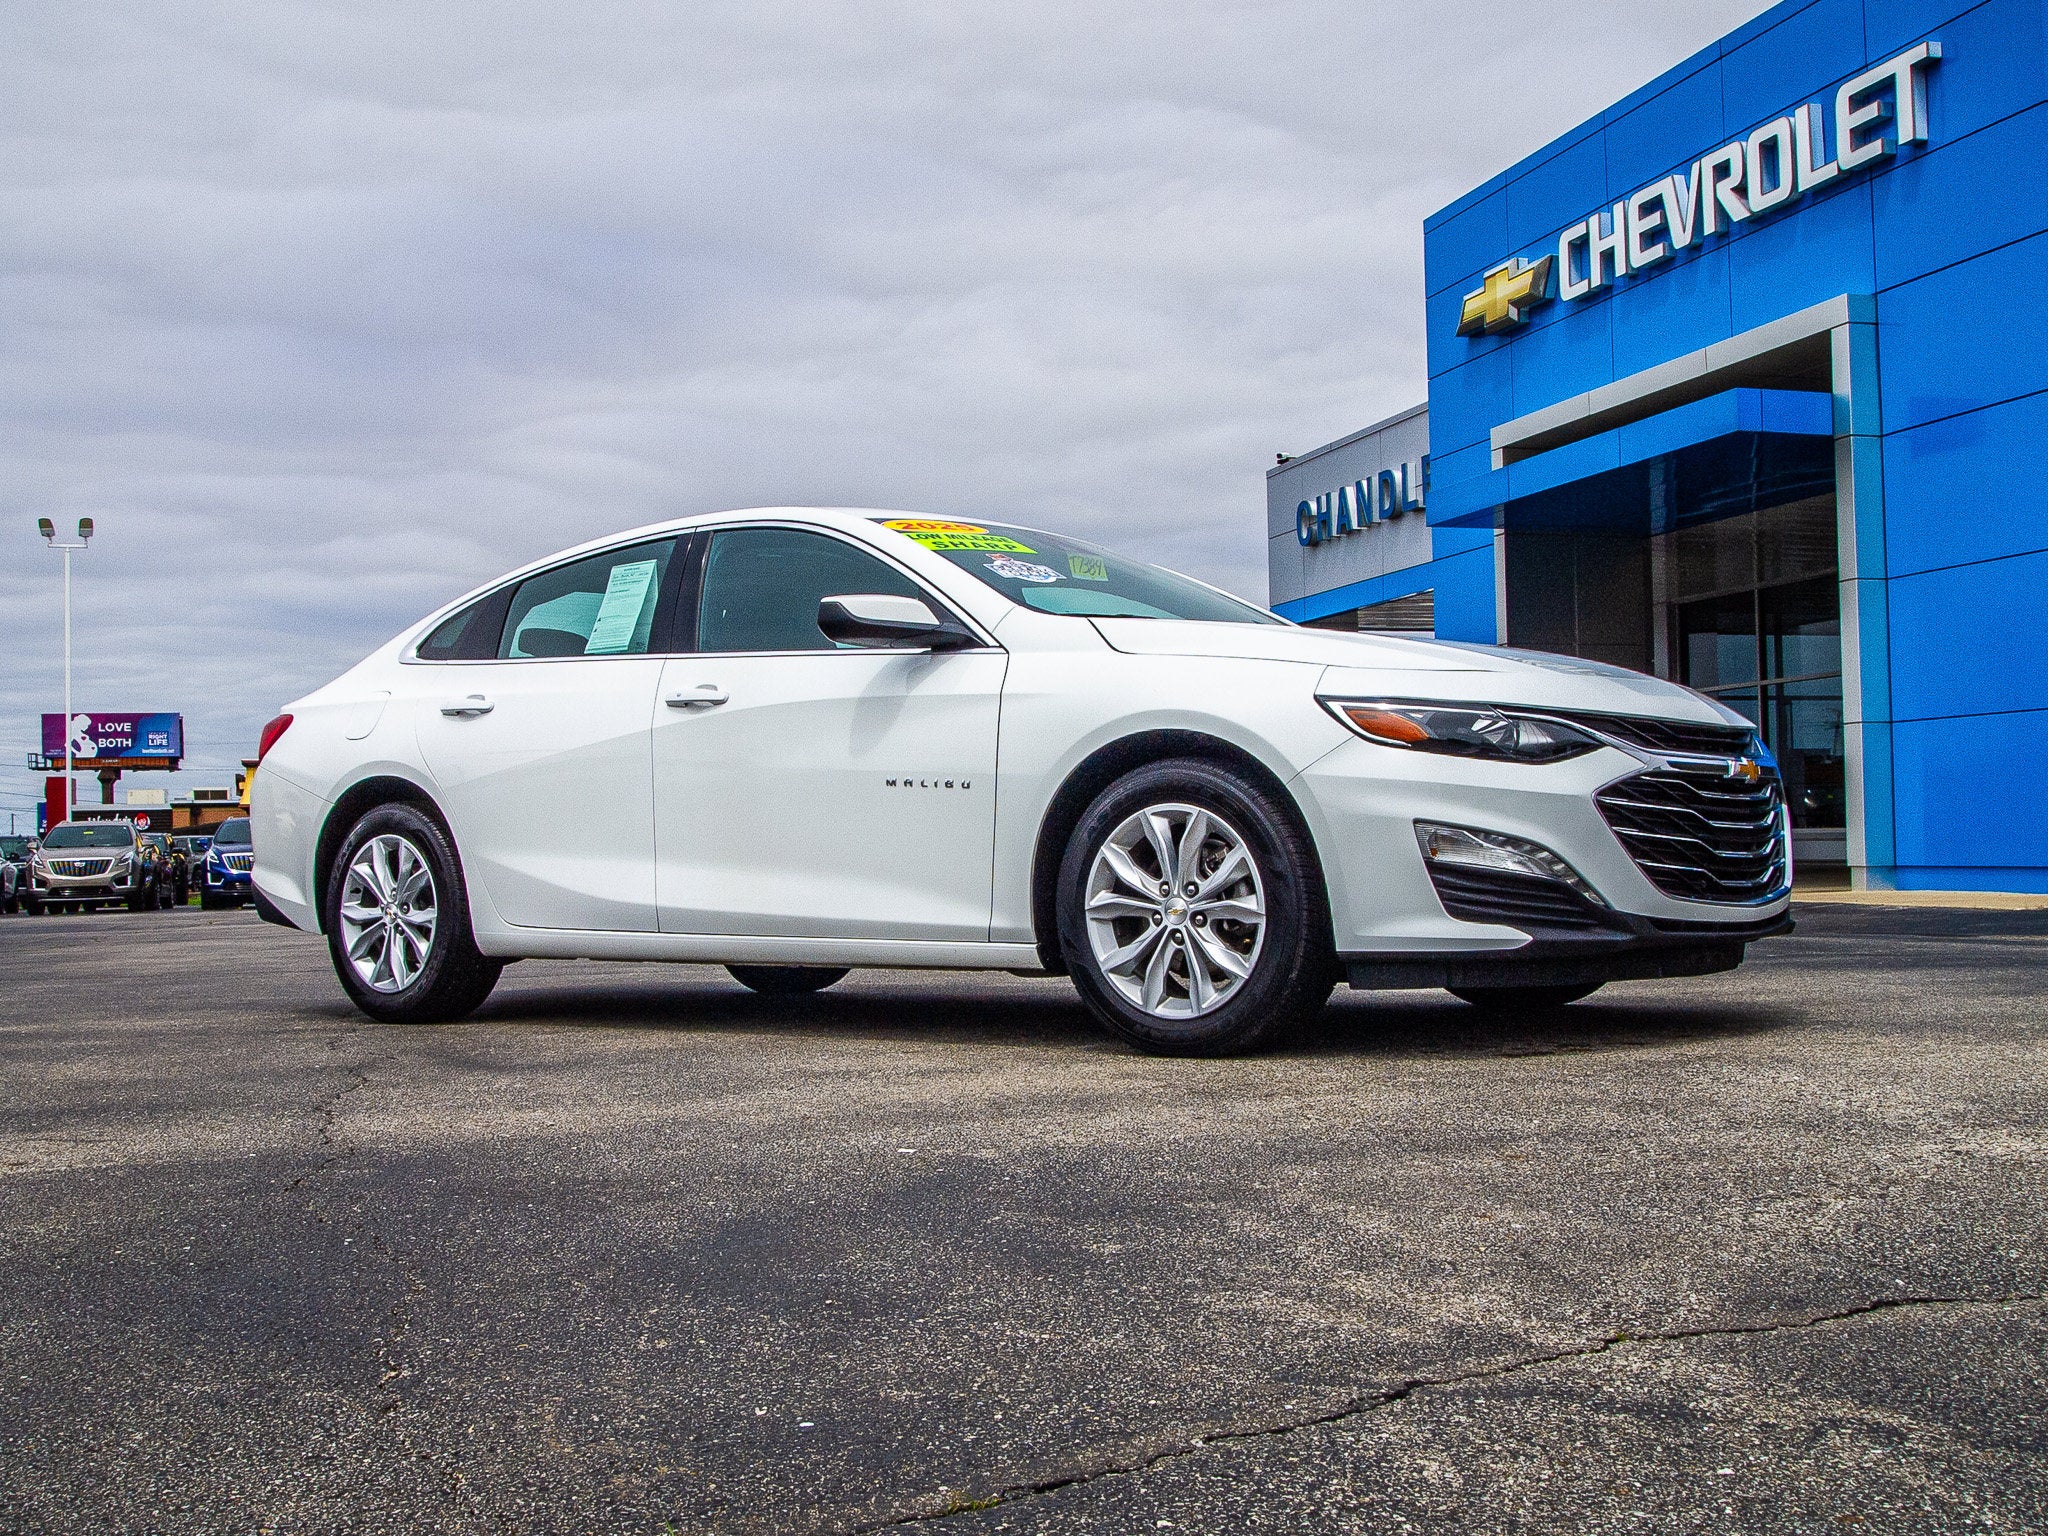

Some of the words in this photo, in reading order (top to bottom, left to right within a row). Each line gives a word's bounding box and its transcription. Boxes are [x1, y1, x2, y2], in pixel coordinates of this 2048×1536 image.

[1558, 41, 1942, 302] CHEVROLET
[906, 533, 942, 541] LOW
[944, 533, 1013, 544] MILEAGE
[932, 541, 1018, 550] SHARP
[98, 722, 132, 732] LOVE
[98, 738, 132, 748] BOTH
[885, 779, 971, 789] MALIBU
